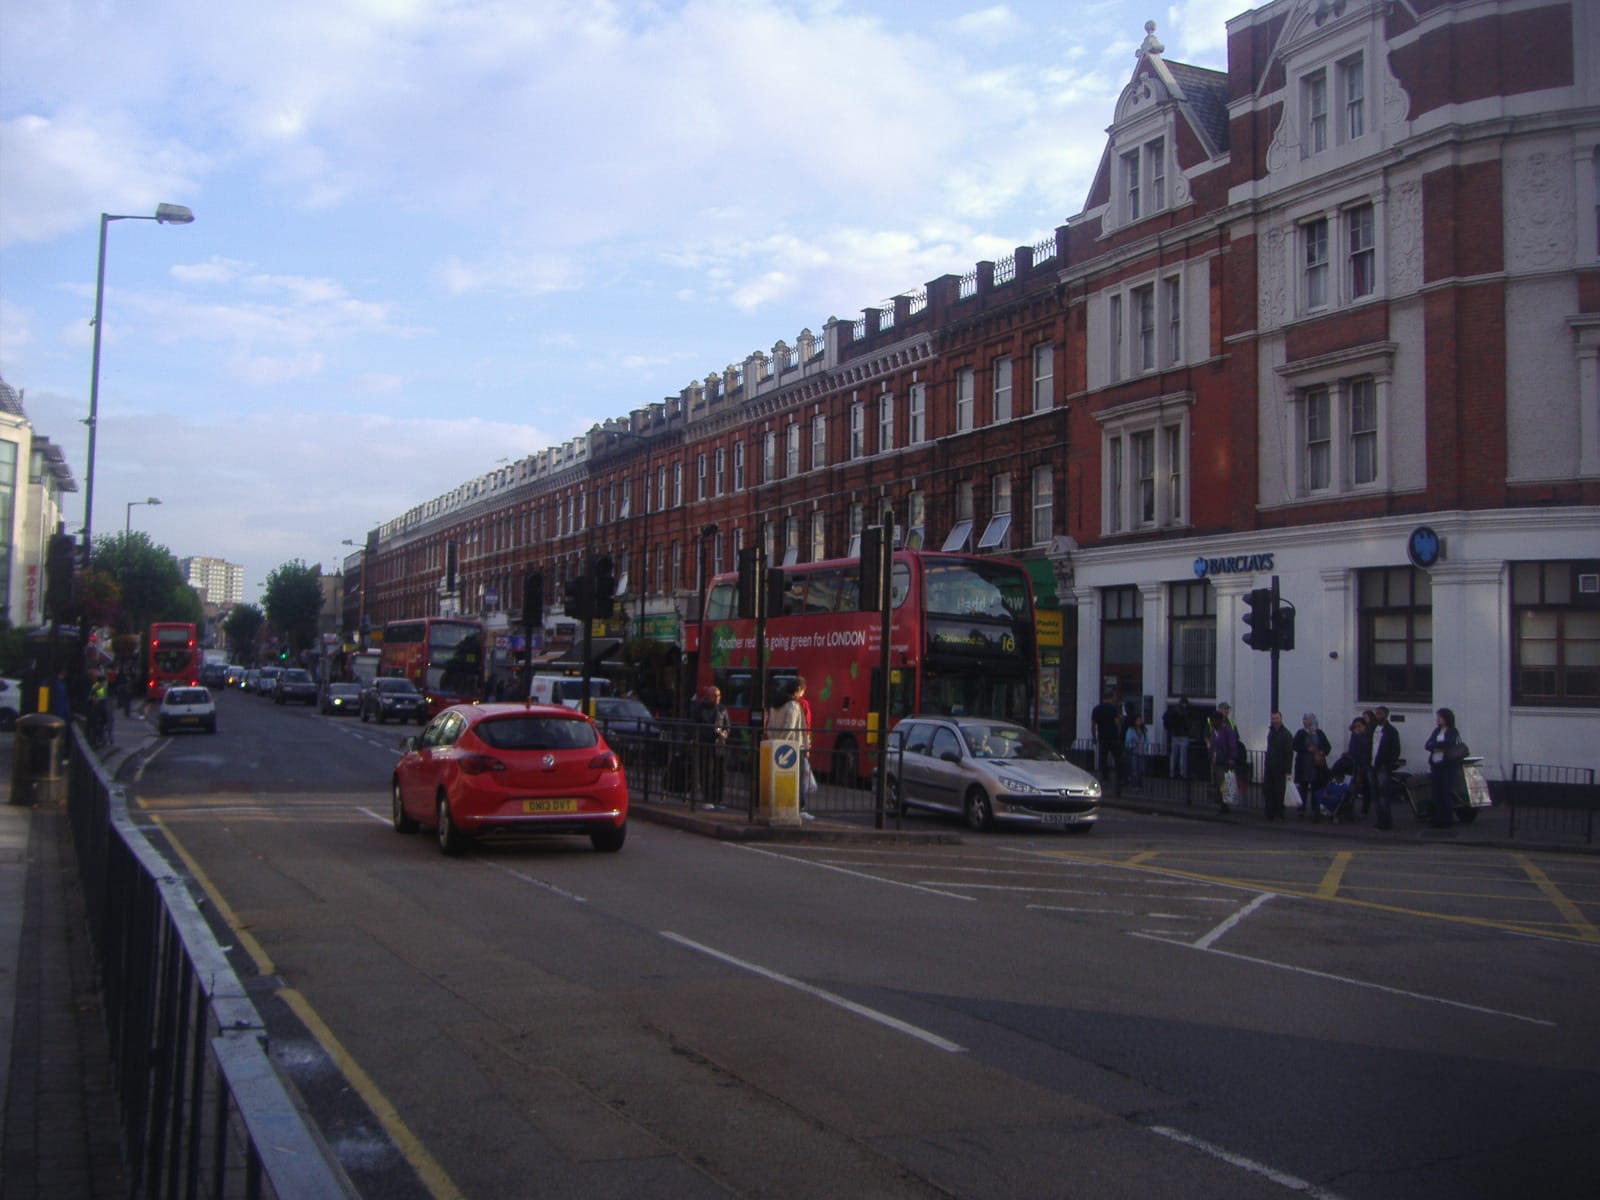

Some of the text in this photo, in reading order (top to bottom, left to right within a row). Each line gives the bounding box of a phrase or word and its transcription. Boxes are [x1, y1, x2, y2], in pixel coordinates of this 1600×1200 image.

[1209, 552, 1274, 575] BARCLAYS
[718, 635, 743, 649] Another
[744, 635, 757, 649] red
[770, 634, 789, 651] going
[790, 634, 813, 650] green
[813, 632, 826, 648] for
[826, 630, 866, 647] LONDON
[1001, 634, 1016, 654] 16
